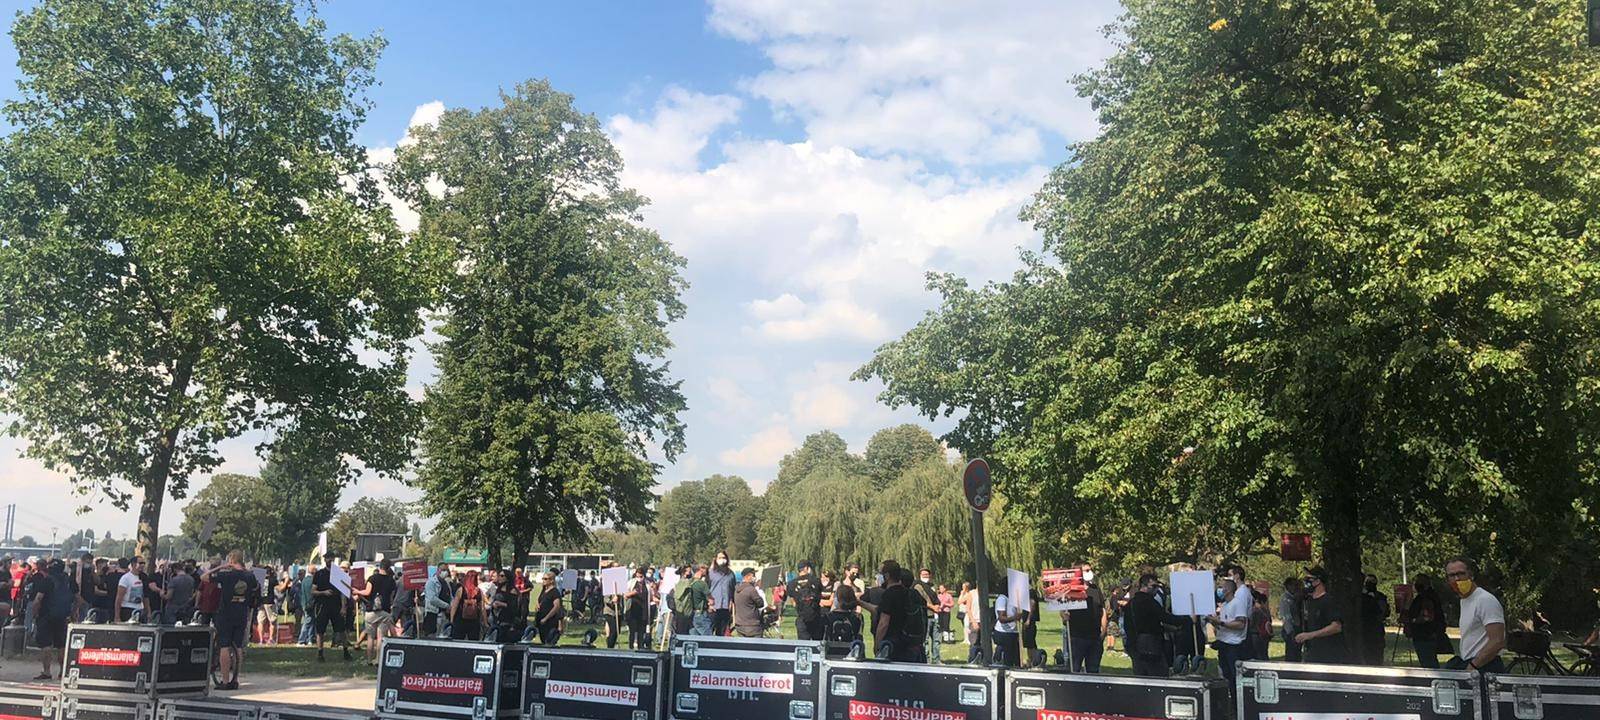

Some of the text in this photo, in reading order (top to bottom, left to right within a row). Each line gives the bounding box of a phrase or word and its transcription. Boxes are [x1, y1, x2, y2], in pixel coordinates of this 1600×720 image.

[81, 651, 140, 665] #alarmstuferot
[402, 676, 481, 692] #alarmstuferot
[691, 673, 791, 690] #alarmstuferot
[548, 683, 637, 702] #alarmstuferot
